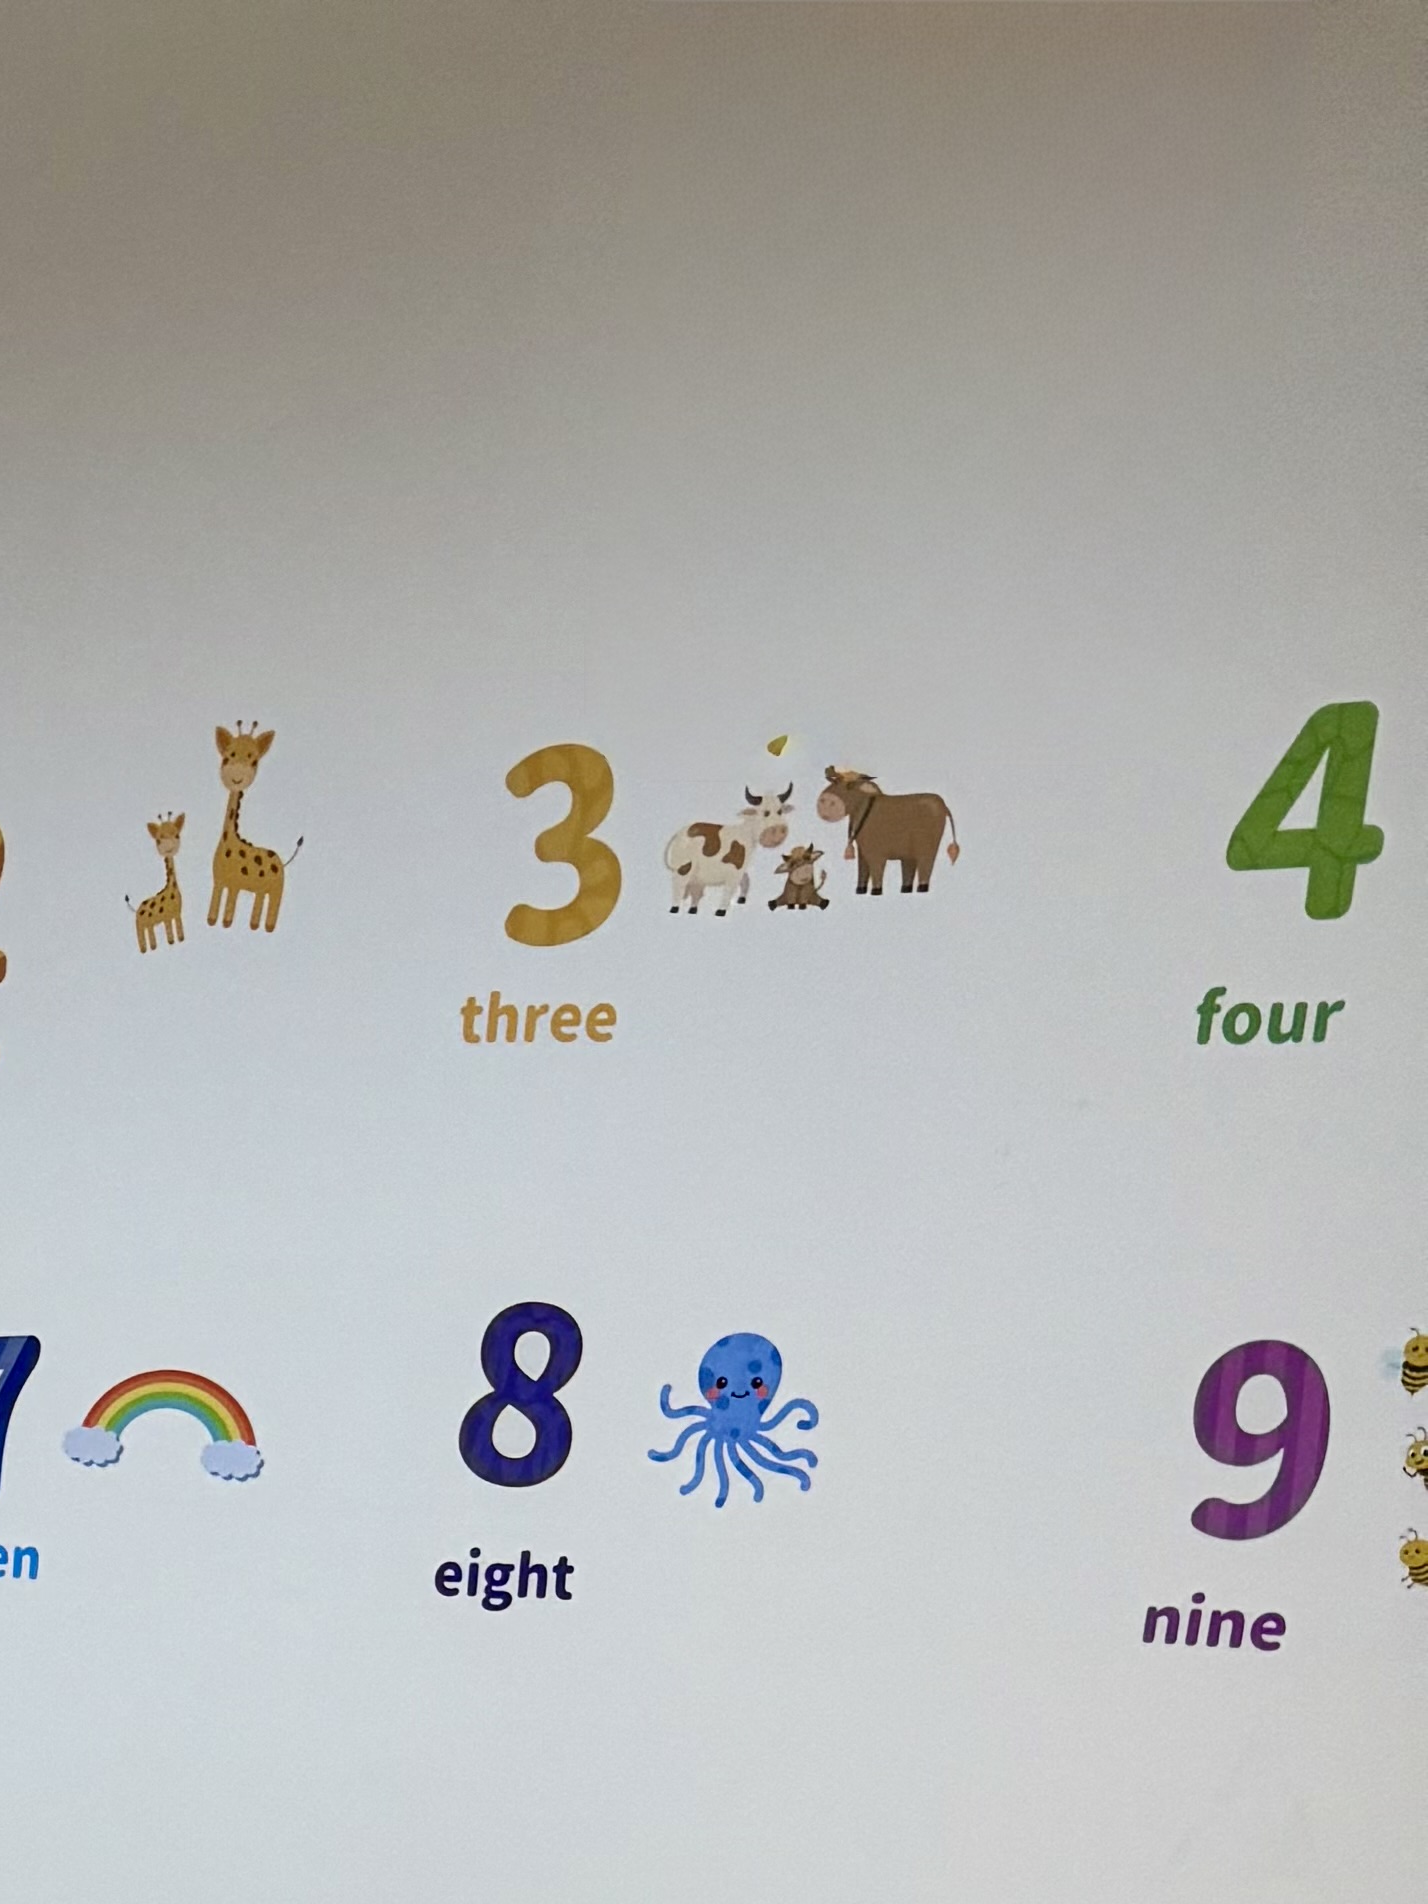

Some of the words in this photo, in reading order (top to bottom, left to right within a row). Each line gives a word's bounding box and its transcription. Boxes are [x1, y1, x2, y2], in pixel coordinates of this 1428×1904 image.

[505, 743, 622, 947] 3
[1226, 700, 1384, 920] 4
[460, 991, 617, 1044] three
[1196, 986, 1346, 1045] four
[458, 1301, 583, 1488] 8
[1191, 1339, 1331, 1541] 9
[435, 1547, 574, 1611] eight
[1142, 1592, 1286, 1651] nine
